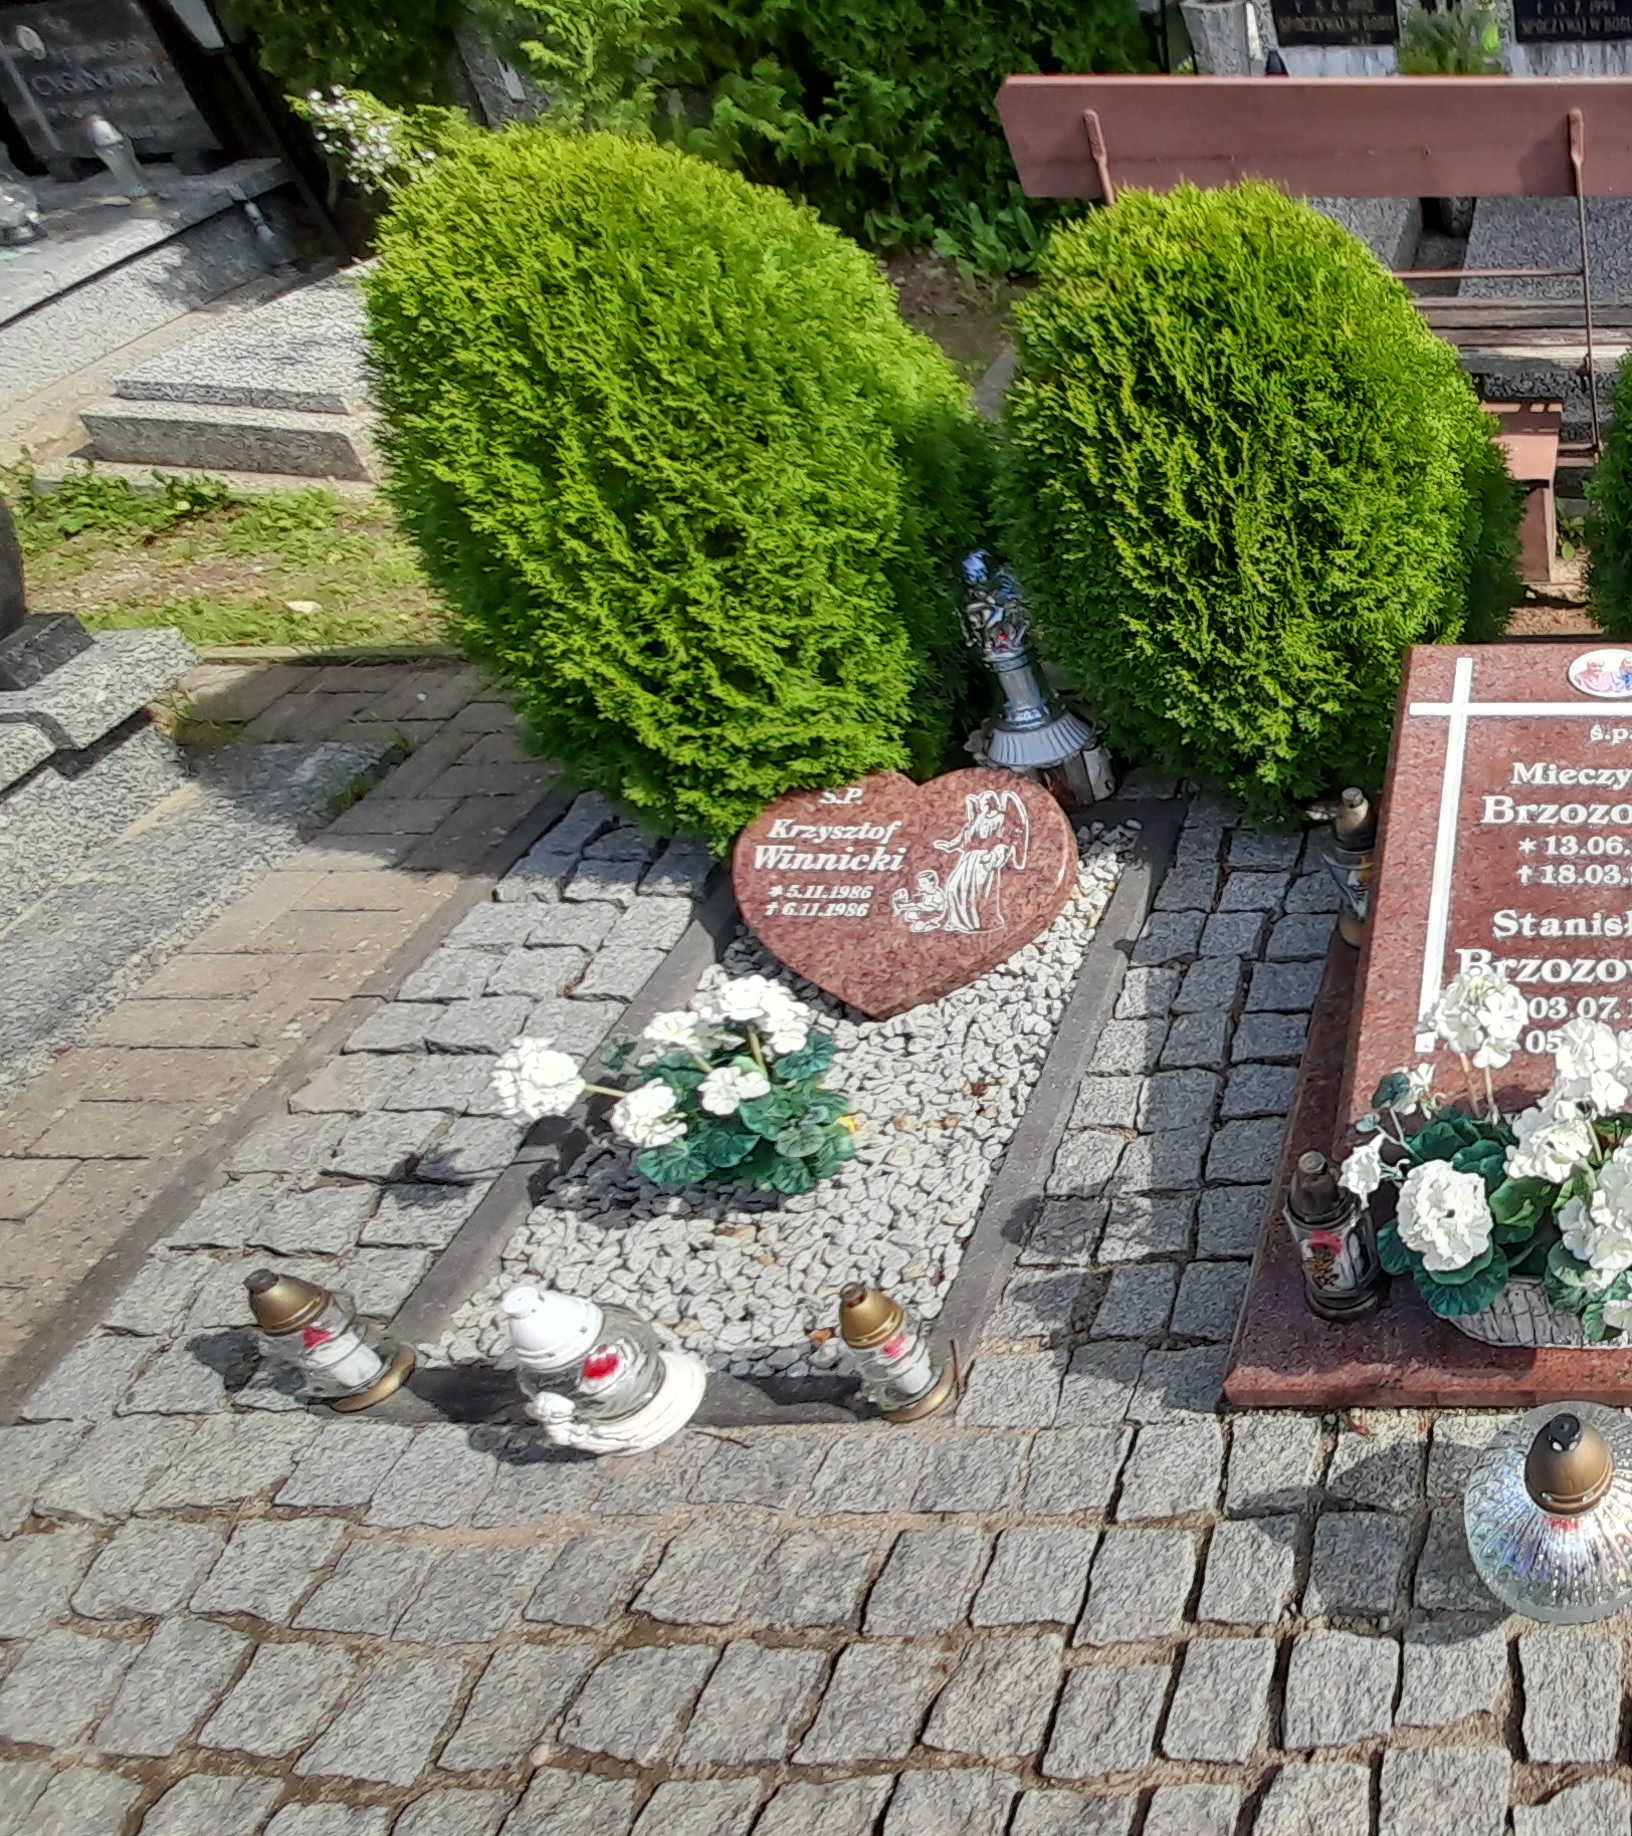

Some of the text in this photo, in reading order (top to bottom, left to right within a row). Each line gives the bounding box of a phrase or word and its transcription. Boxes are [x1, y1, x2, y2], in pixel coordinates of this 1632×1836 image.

[767, 818, 902, 844] Krzysztof
[754, 845, 907, 871] Winnicki
[785, 885, 874, 899] 5.11.1986
[781, 902, 870, 917] 6.11.1986
